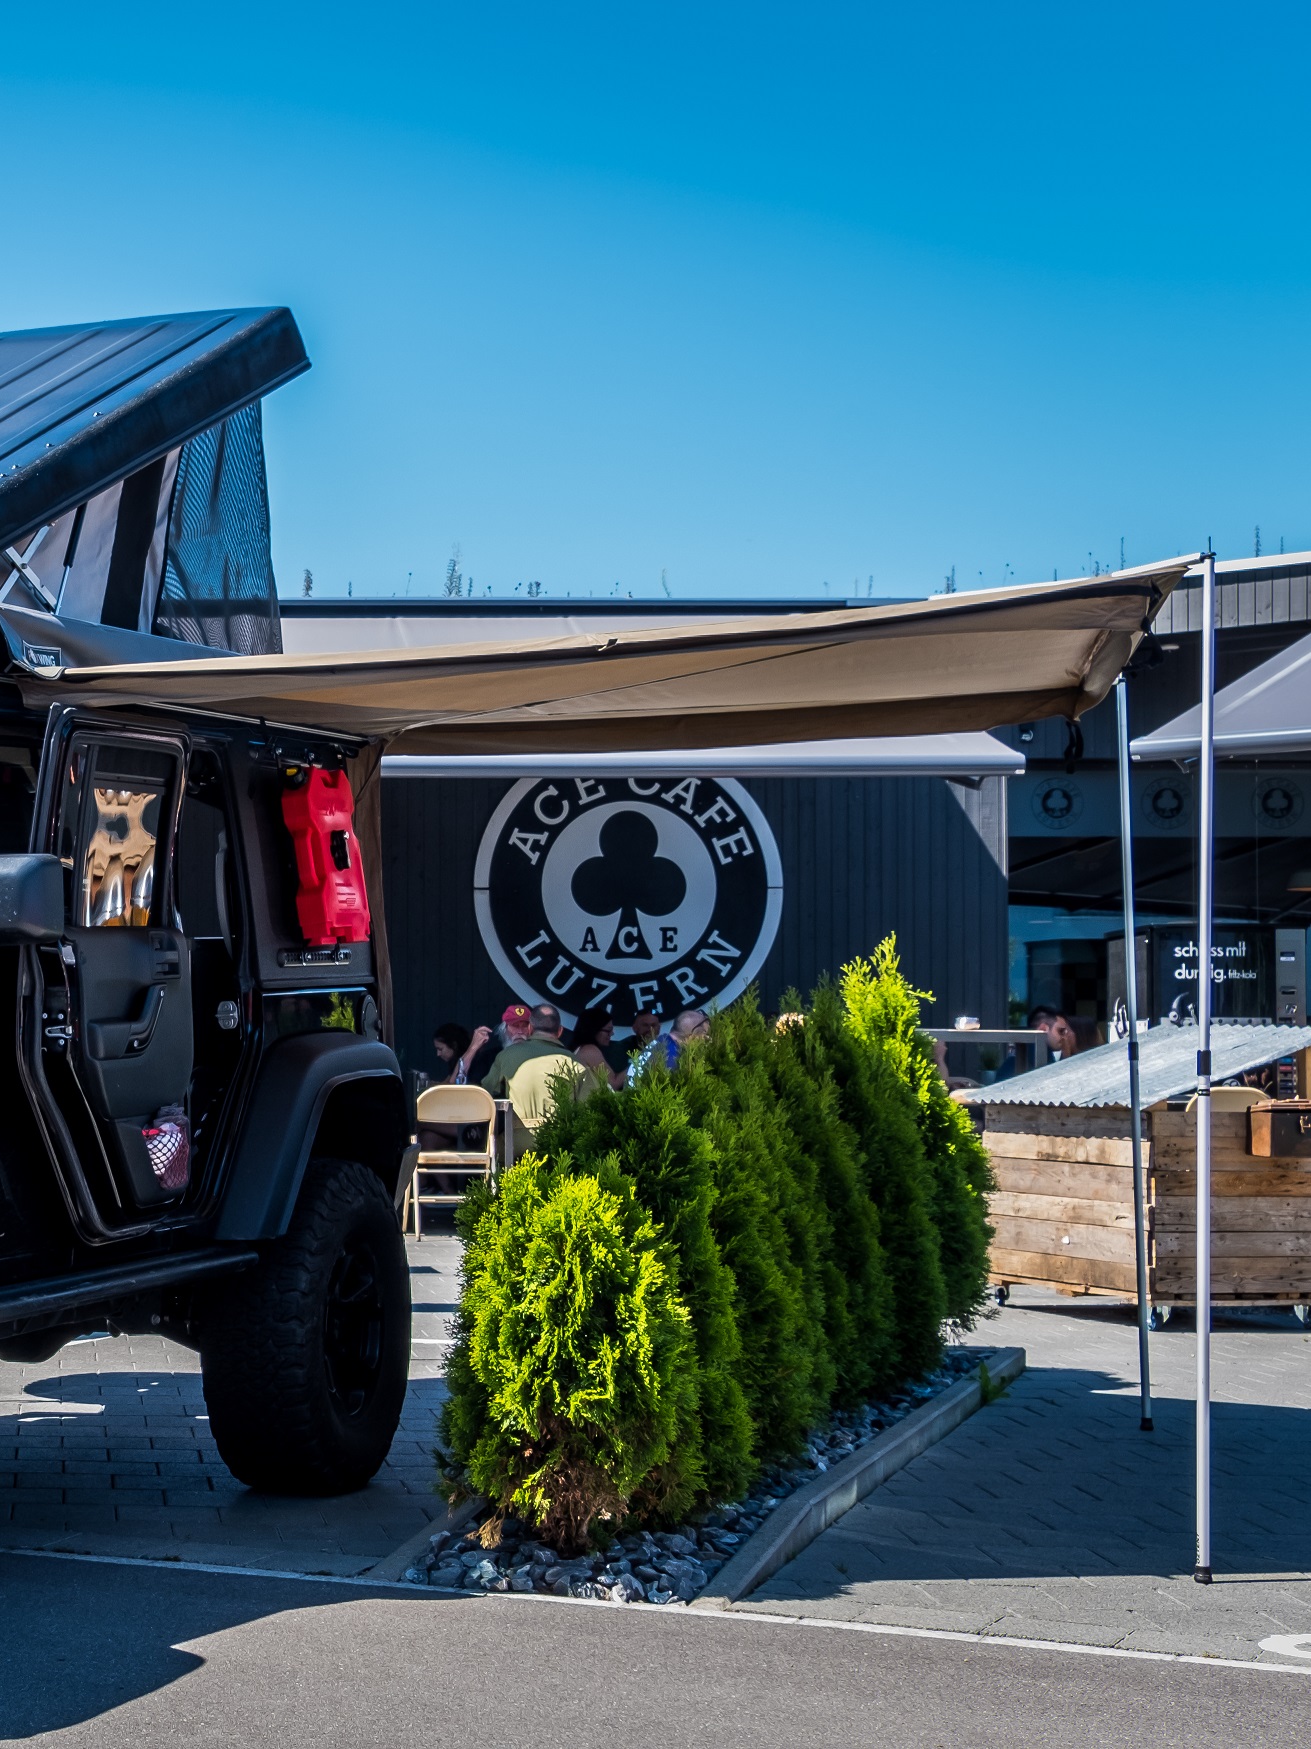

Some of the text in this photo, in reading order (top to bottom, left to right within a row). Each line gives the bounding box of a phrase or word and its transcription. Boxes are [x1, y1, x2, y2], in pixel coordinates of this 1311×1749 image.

[508, 778, 606, 866] ACE
[579, 926, 678, 953] ACE
[1173, 941, 1246, 957] schss mit
[516, 929, 742, 1017] LUZERN
[1174, 963, 1227, 983] durig.
